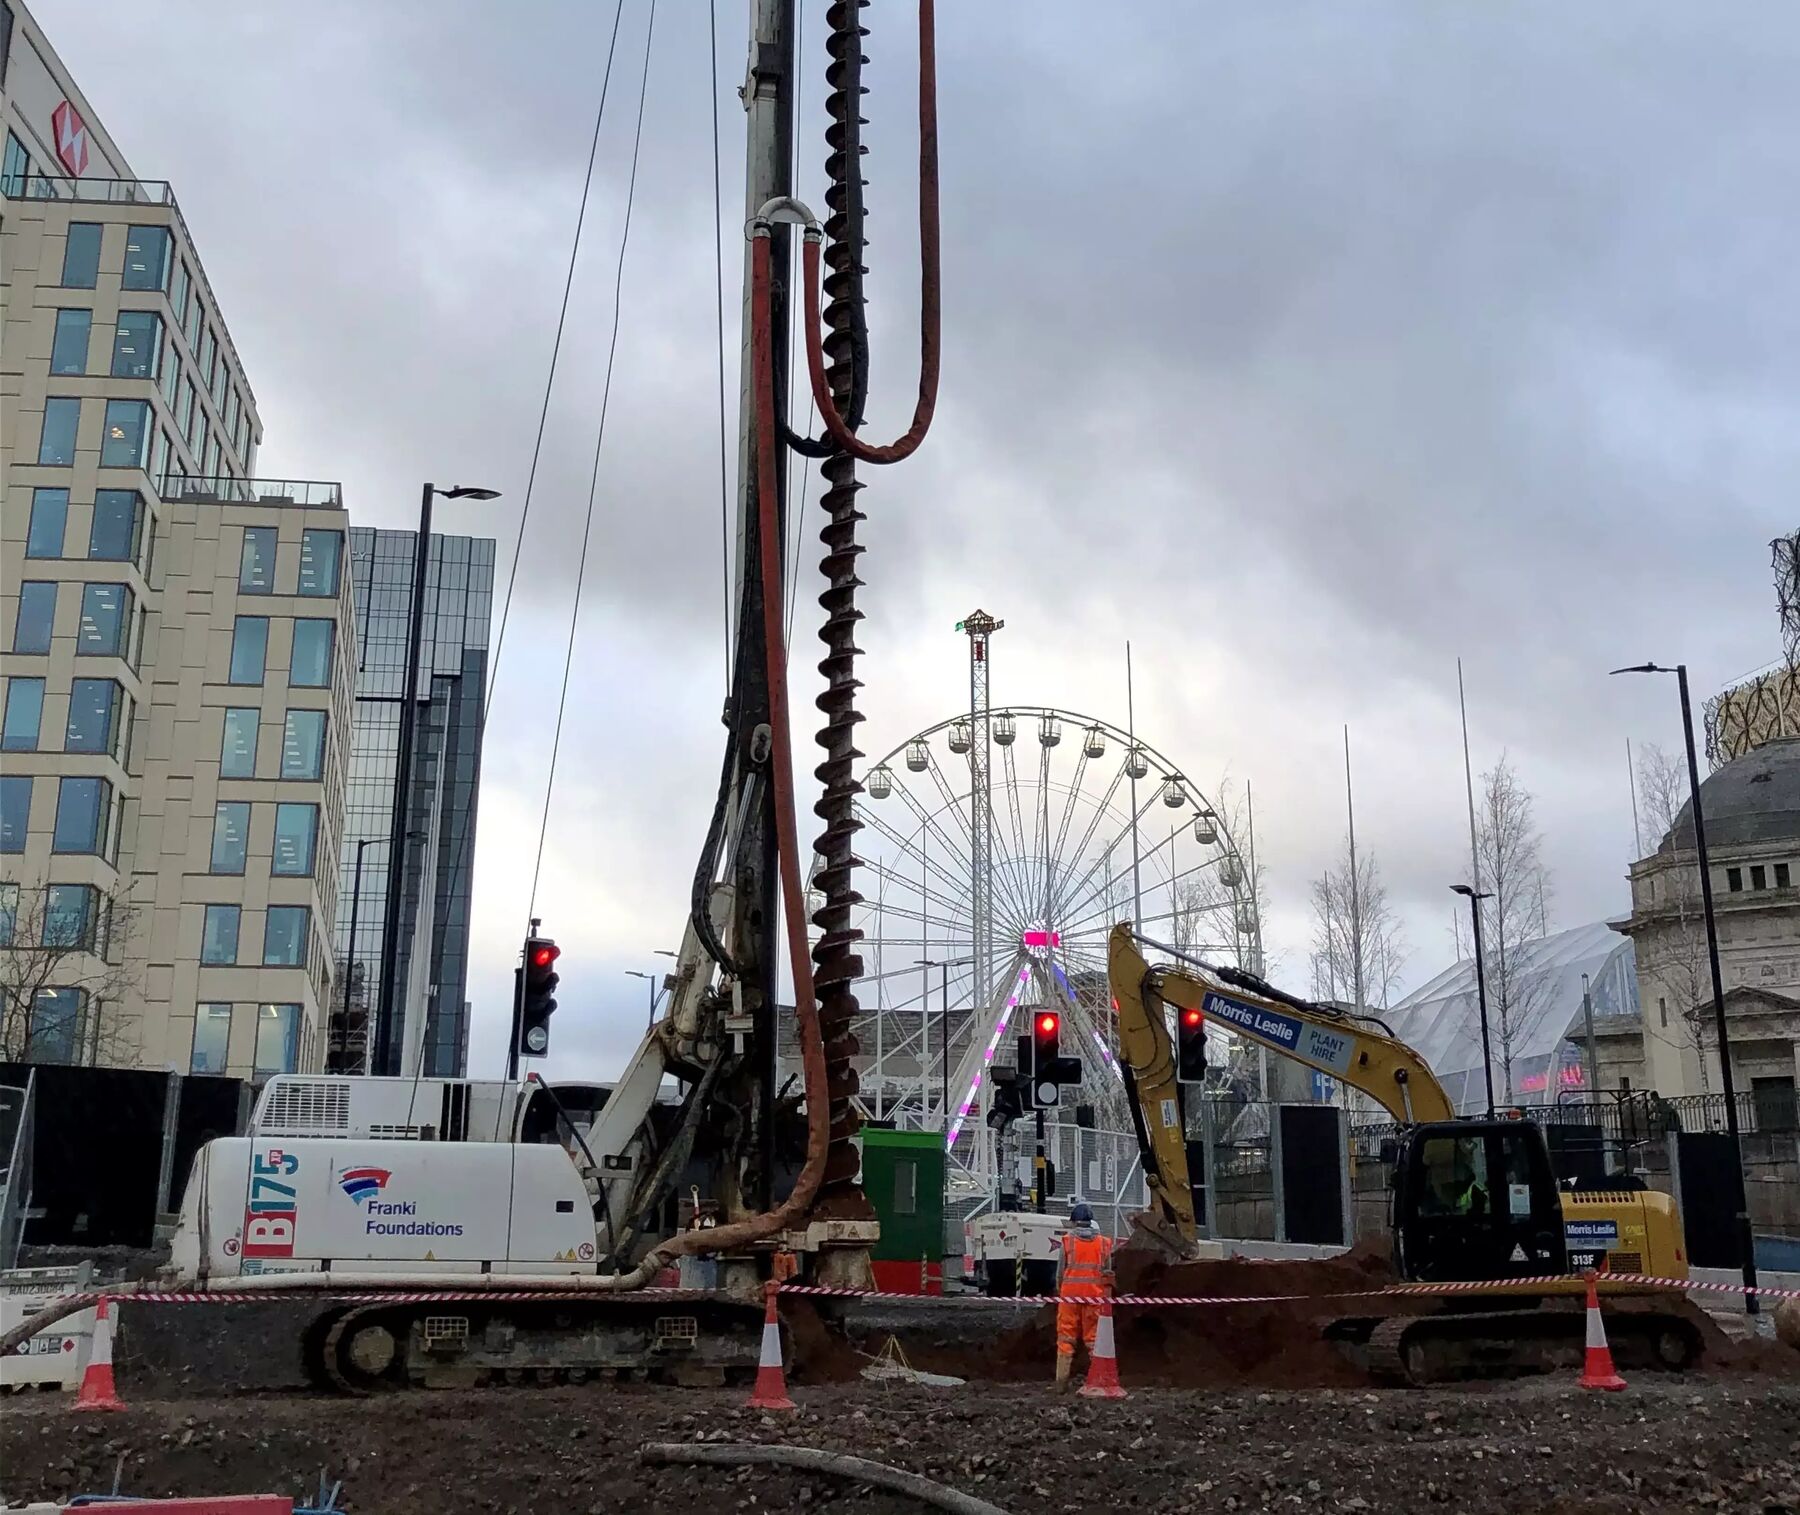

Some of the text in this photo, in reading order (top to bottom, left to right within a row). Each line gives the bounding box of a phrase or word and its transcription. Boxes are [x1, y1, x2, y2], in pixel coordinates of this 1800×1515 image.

[1210, 997, 1293, 1040] Morris Leslie
[1310, 1030, 1345, 1051] PLANT
[1310, 1045, 1336, 1062] HIRE
[246, 1153, 299, 1245] B175
[368, 1200, 416, 1215] Franki
[366, 1220, 463, 1236] Foundations
[1566, 1224, 1592, 1235] Morris
[1593, 1224, 1616, 1235] Leslie
[1572, 1254, 1595, 1266] 313F
